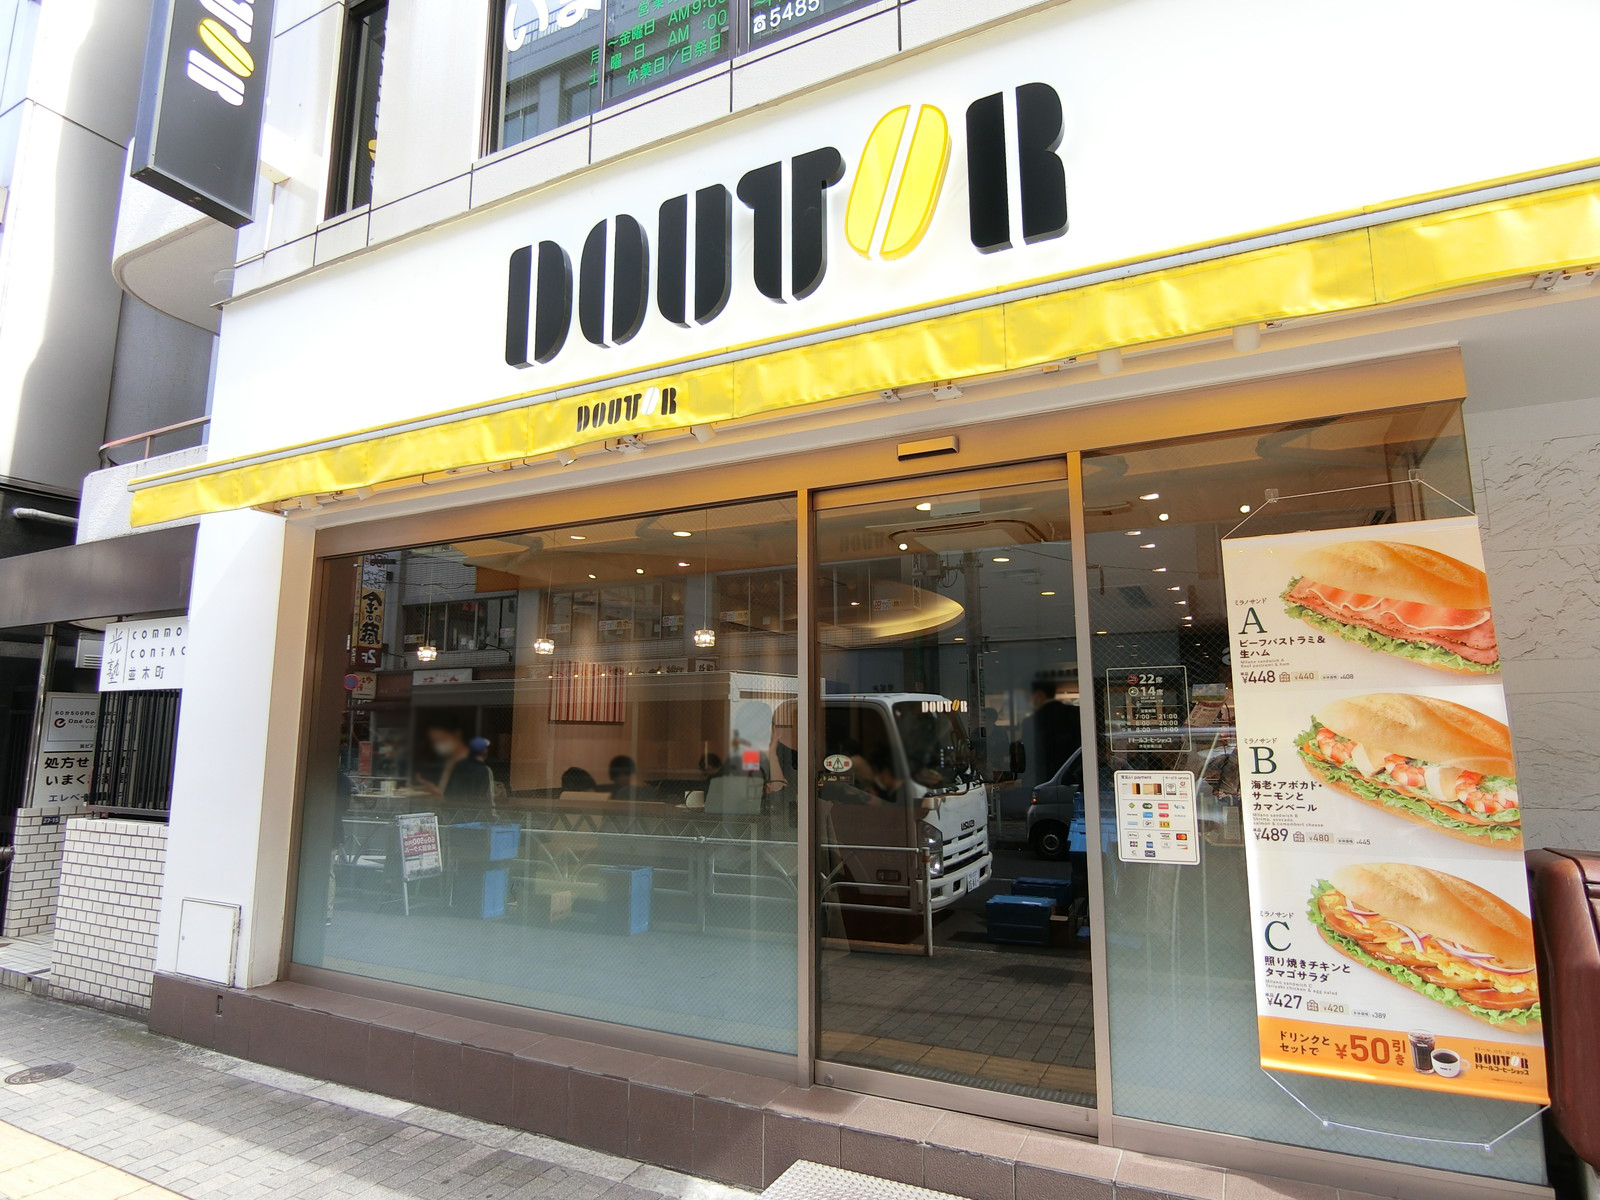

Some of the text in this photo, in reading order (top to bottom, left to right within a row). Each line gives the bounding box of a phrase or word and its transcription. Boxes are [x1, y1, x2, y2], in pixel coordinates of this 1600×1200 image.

[187, 0, 255, 107] TOR
[504, 81, 1070, 370] DOUTOR
[576, 387, 677, 433] DOUTOR
[1238, 607, 1268, 635] A
[1239, 649, 1271, 659] 生ハム
[1241, 670, 1276, 684] ¥448
[921, 699, 968, 713] DOUTOR
[1248, 746, 1277, 775] B
[1252, 791, 1304, 801] サーモンと
[1253, 802, 1318, 812] カマンベール
[1255, 827, 1289, 842] ¥489
[1264, 920, 1292, 952] C
[1264, 955, 1351, 974] 照り焼きチキンと
[1265, 967, 1330, 983] タマゴサラダ
[1266, 993, 1303, 1010] ¥427
[1280, 1030, 1330, 1046] ドリンクと
[1280, 1042, 1320, 1056] セットで
[1334, 1034, 1391, 1065] ¥50
[1474, 1052, 1529, 1069] DOUTOR
